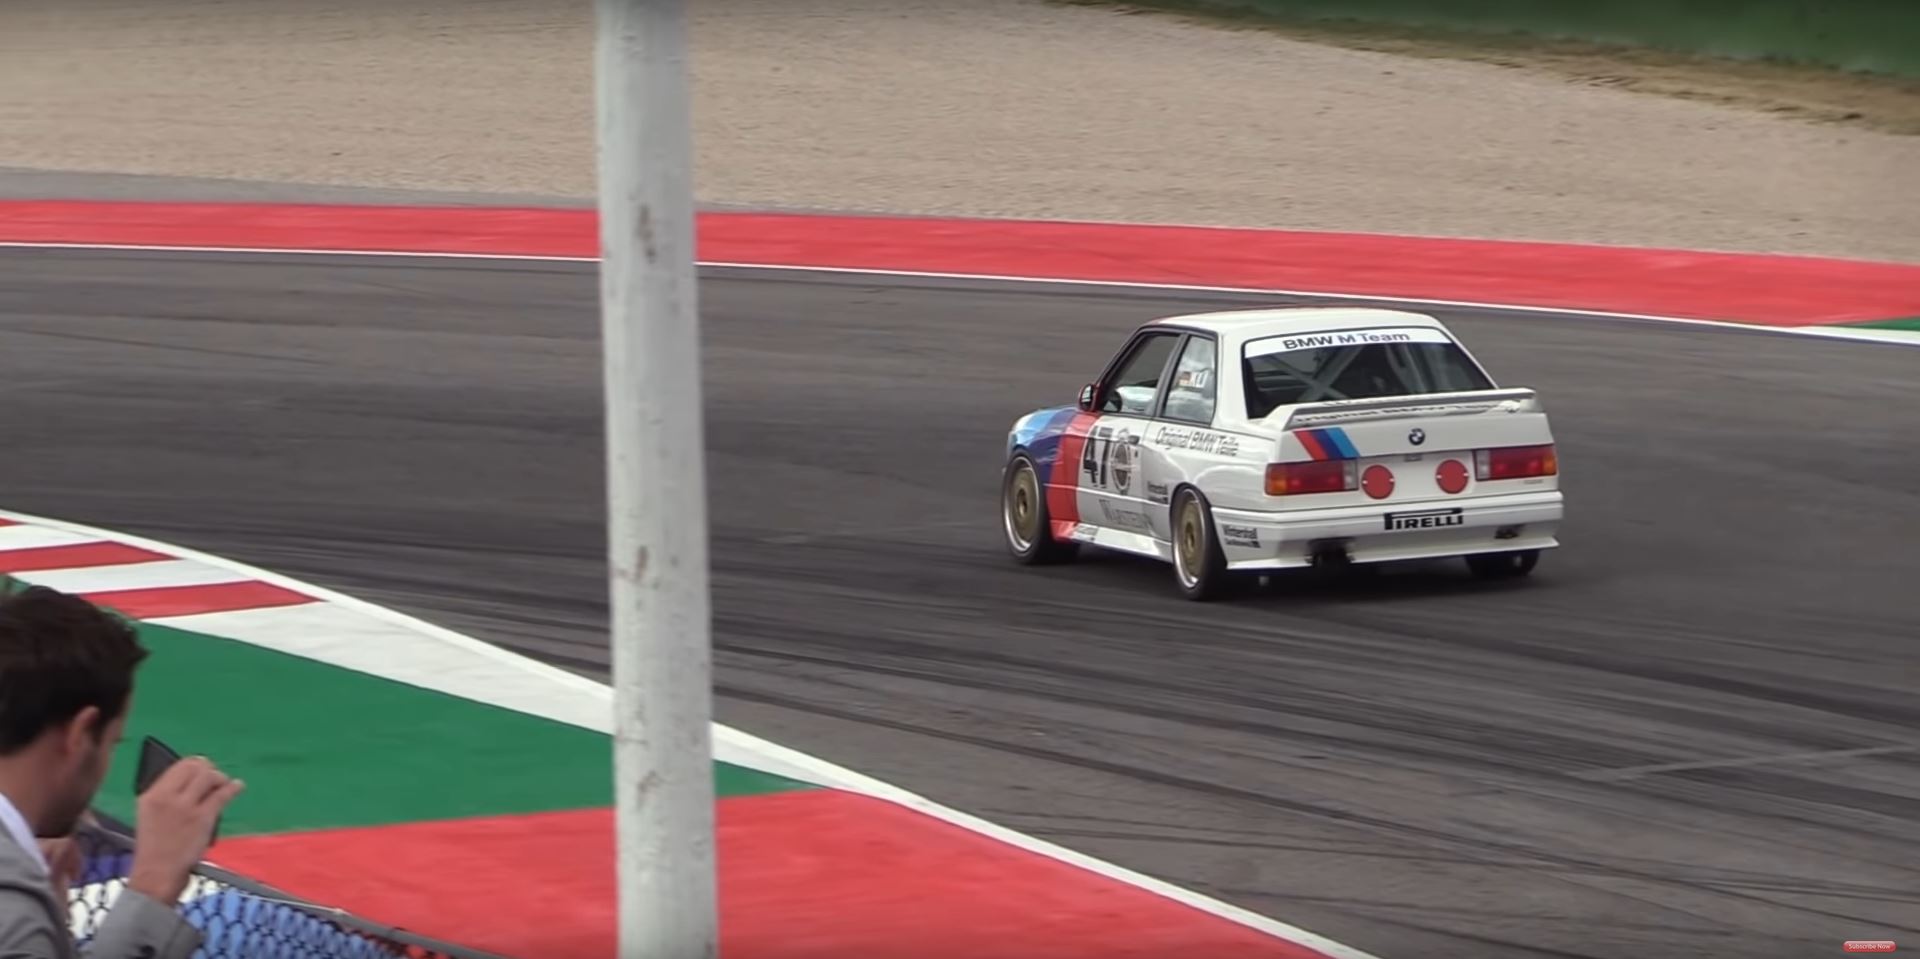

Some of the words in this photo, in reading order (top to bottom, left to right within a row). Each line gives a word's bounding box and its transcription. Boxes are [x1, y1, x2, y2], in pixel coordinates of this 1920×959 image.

[1282, 335, 1333, 350] BMW
[1336, 333, 1359, 344] M
[1358, 332, 1410, 342] Team
[1155, 426, 1193, 451] Original
[1384, 507, 1464, 531] PIRELLI
